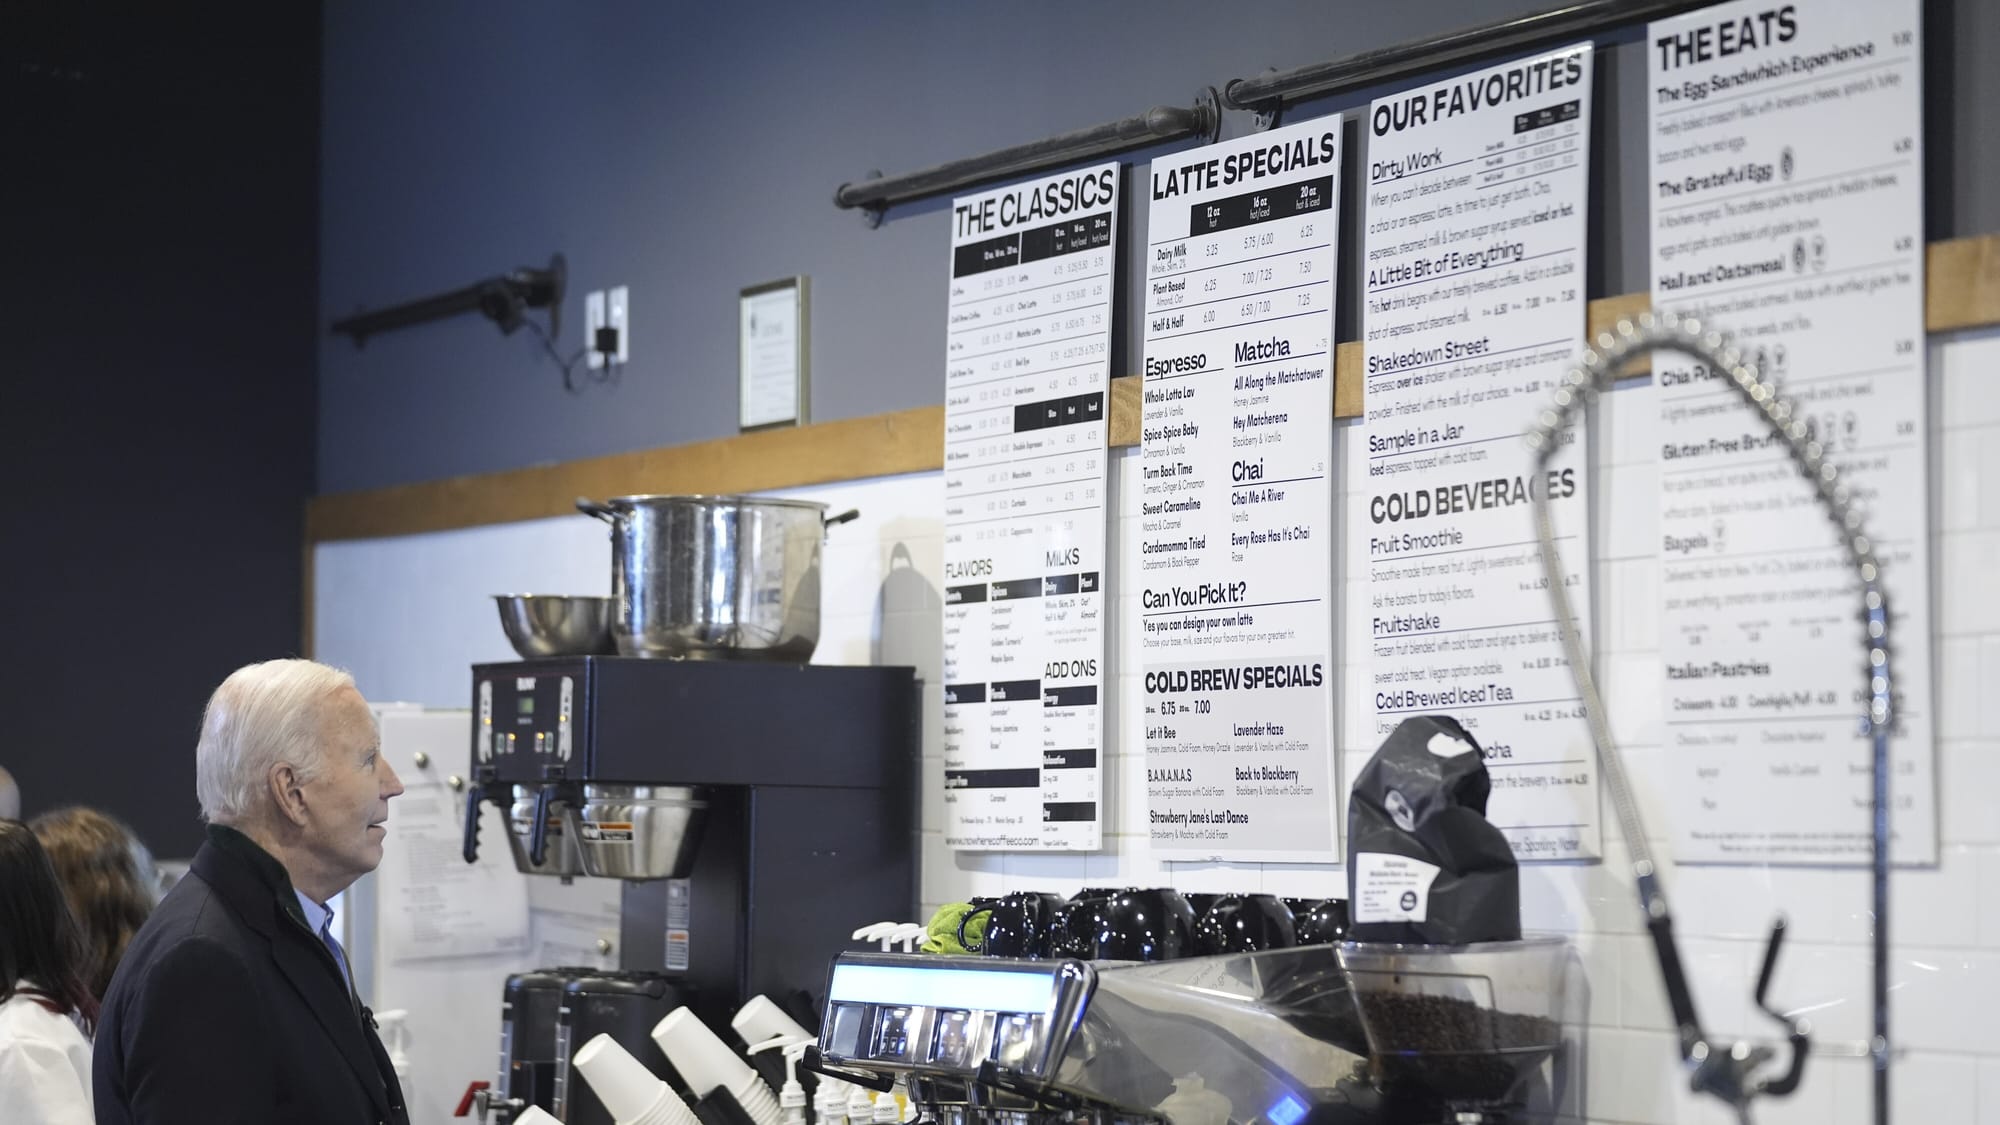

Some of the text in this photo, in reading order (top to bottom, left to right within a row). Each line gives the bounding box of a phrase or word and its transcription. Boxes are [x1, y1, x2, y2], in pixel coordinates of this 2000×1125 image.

[1657, 5, 1797, 71] THE EATS
[1657, 87, 1681, 104] The
[1683, 81, 1709, 101] Egg
[1792, 42, 1875, 74] Experience
[1373, 95, 1427, 137] OUR
[1433, 53, 1582, 122] FAVORITES
[1153, 132, 1334, 201] LATTE SPECIALS
[1372, 147, 1443, 180] Dirty Work
[1659, 163, 1773, 199] The Grateful Egg
[1301, 186, 1309, 197] 20
[956, 170, 1113, 238] THE CLASSICS
[1254, 197, 1259, 207] 16
[1296, 197, 1320, 210] hot & iced
[1207, 207, 1213, 217] 12
[1250, 207, 1270, 220] hot/iced
[1209, 219, 1217, 228] hot
[1300, 225, 1313, 238] 6.25
[1244, 233, 1273, 249] 5.75 6.00
[1157, 246, 1186, 261] Dairy Milk
[1206, 244, 1218, 256] 5.25
[1300, 261, 1311, 274] 7.50
[1369, 241, 1524, 288] A Little Bit of Everything
[1242, 268, 1272, 284] 7.00 7.25
[1687, 268, 1714, 285] and
[1153, 278, 1185, 294] Plant Based
[1205, 279, 1216, 291] 6.25
[1241, 300, 1270, 316] 6.50 7.00
[1298, 294, 1310, 306] 7.25
[1153, 315, 1184, 331] Half & Half
[1204, 310, 1215, 322] 6.00
[1235, 336, 1290, 363] Matcha
[1368, 337, 1489, 374] Shakedown Street
[1146, 353, 1206, 378] Espresso
[1234, 368, 1324, 391] All Along the Matchatower
[1397, 375, 1423, 390] over ice
[1145, 387, 1194, 404] Whole Lotta Lav
[1234, 394, 1269, 408] Honey Jasmine
[1233, 412, 1288, 431] Hey Matcherena
[1144, 422, 1199, 444] Spice Spice Baby
[1369, 423, 1464, 453] Sample in a Jar
[1710, 439, 1738, 453] Free
[1143, 462, 1192, 480] Turm Back Time
[1232, 457, 1263, 481] Chai
[1369, 463, 1384, 477] Iced
[1232, 489, 1284, 506] Chai Me A River
[1143, 497, 1201, 516] Sweet Carameline
[1371, 490, 1431, 524] COLD
[1232, 511, 1248, 523] Vanilla
[1143, 534, 1205, 554] Cardamomma Tried
[1232, 526, 1310, 548] Every Rose Has It's Chai
[1371, 528, 1463, 555] Fruit Smoothie
[1046, 548, 1079, 567] MILKS
[1232, 552, 1243, 562] Rose
[946, 558, 992, 578] FLAVORS
[1143, 581, 1246, 609] Can You Pick It?
[1143, 611, 1253, 635] Yes you can design your own latte
[1373, 613, 1440, 635] Fruitshake
[1045, 659, 1097, 679] ADD ONS
[1668, 660, 1770, 679] Italian Pastries
[1146, 664, 1322, 694] COLD BREW SPECIALS
[1376, 684, 1513, 710] Cold Brewed Iced Tea
[1161, 701, 1175, 716] 6.75
[1195, 699, 1210, 714] 7.00
[1146, 726, 1176, 739] Let it Bee
[1234, 722, 1284, 736] Lavender Haze
[1148, 768, 1192, 782] B.A.N.A.N.A.S
[1235, 765, 1299, 784] Back to Blackberry
[1150, 808, 1248, 828] Strawberry Jane's Last Dance
[945, 835, 1039, 846] www.nowherecoffeeco.com
